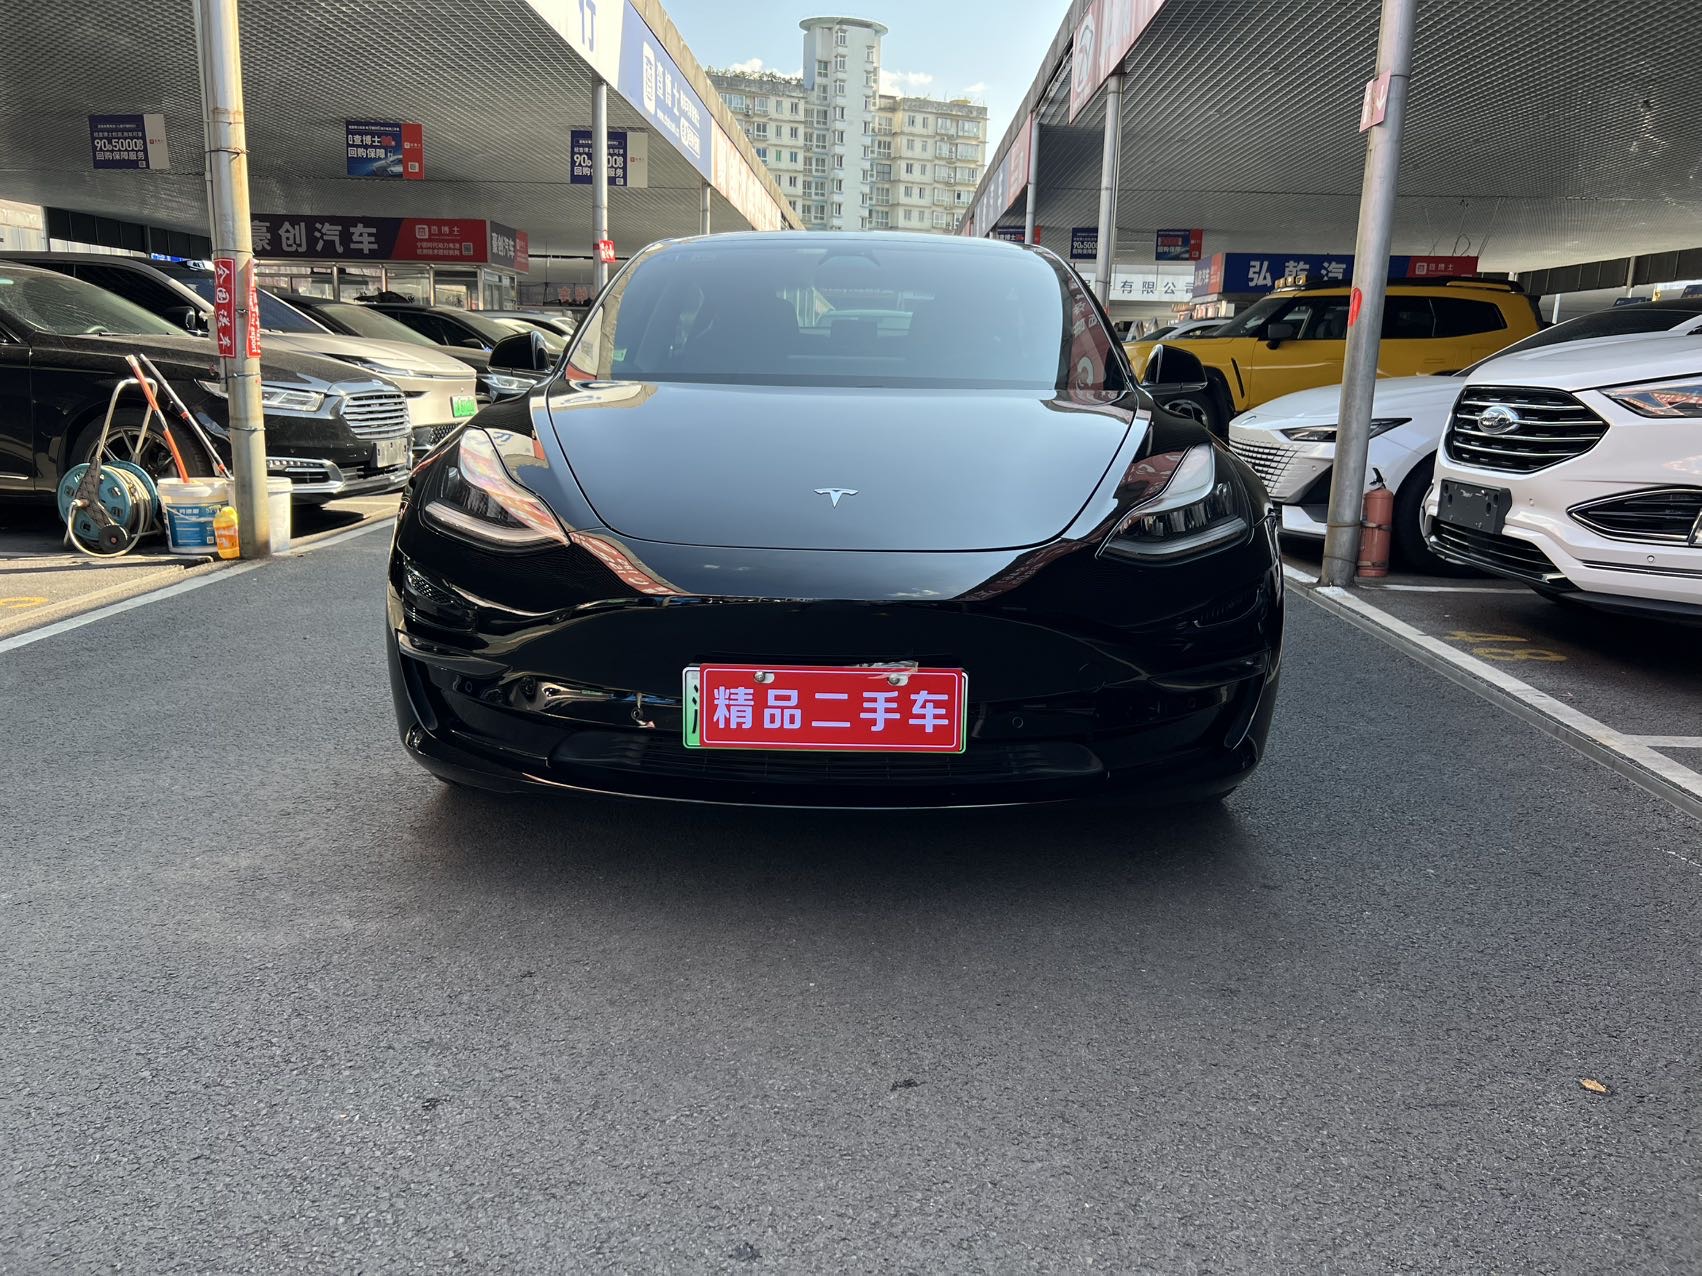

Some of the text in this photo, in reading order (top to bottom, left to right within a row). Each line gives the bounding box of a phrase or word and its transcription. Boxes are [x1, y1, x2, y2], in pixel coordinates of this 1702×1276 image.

[252, 219, 379, 255] 豪创汽车
[713, 685, 949, 733] 精品二手车
